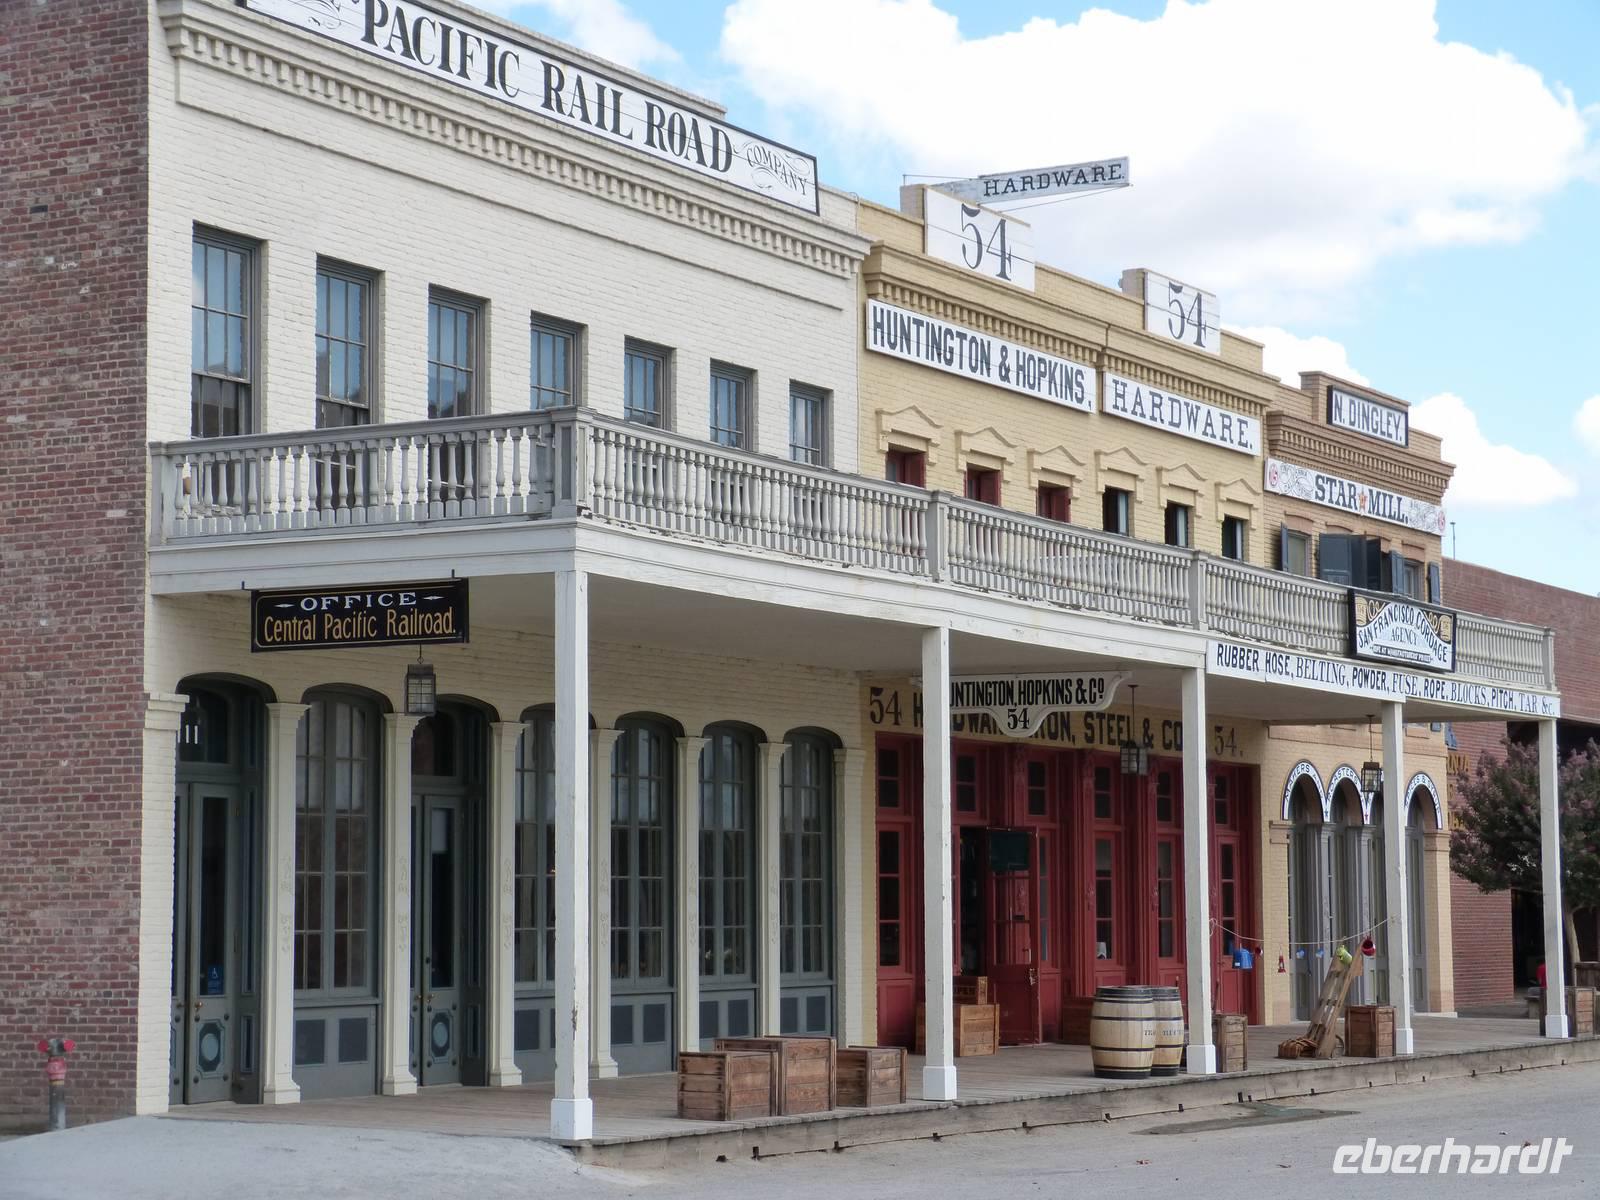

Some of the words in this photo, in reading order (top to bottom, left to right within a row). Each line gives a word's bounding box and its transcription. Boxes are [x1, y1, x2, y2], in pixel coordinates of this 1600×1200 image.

[360, 0, 520, 98] PACIFIC
[541, 60, 634, 141] RAIL
[644, 100, 732, 174] ROAD
[746, 145, 807, 197] COMPANY
[961, 203, 1013, 281] 54
[1168, 281, 1207, 348] 54
[872, 305, 992, 378] HUNTINGTON
[999, 345, 1011, 384] &
[1333, 393, 1347, 424] N.
[1314, 474, 1358, 511] STAR
[1368, 486, 1409, 524] MILL.
[264, 615, 316, 642] Central
[324, 610, 378, 640] Pacific
[300, 592, 417, 611] OFFICE
[1358, 626, 1374, 649] SAN
[1373, 603, 1414, 635] FRANCISCO
[1416, 611, 1448, 663] CORDAGE
[1391, 626, 1419, 646] AGENCY
[1018, 678, 1073, 706] HOPKINS
[1075, 678, 1087, 705] &
[1217, 643, 1259, 672] RUBBER
[1518, 693, 1538, 714] TAR
[869, 686, 903, 726] 54
[1142, 717, 1155, 750] &
[1007, 707, 1030, 730] 54
